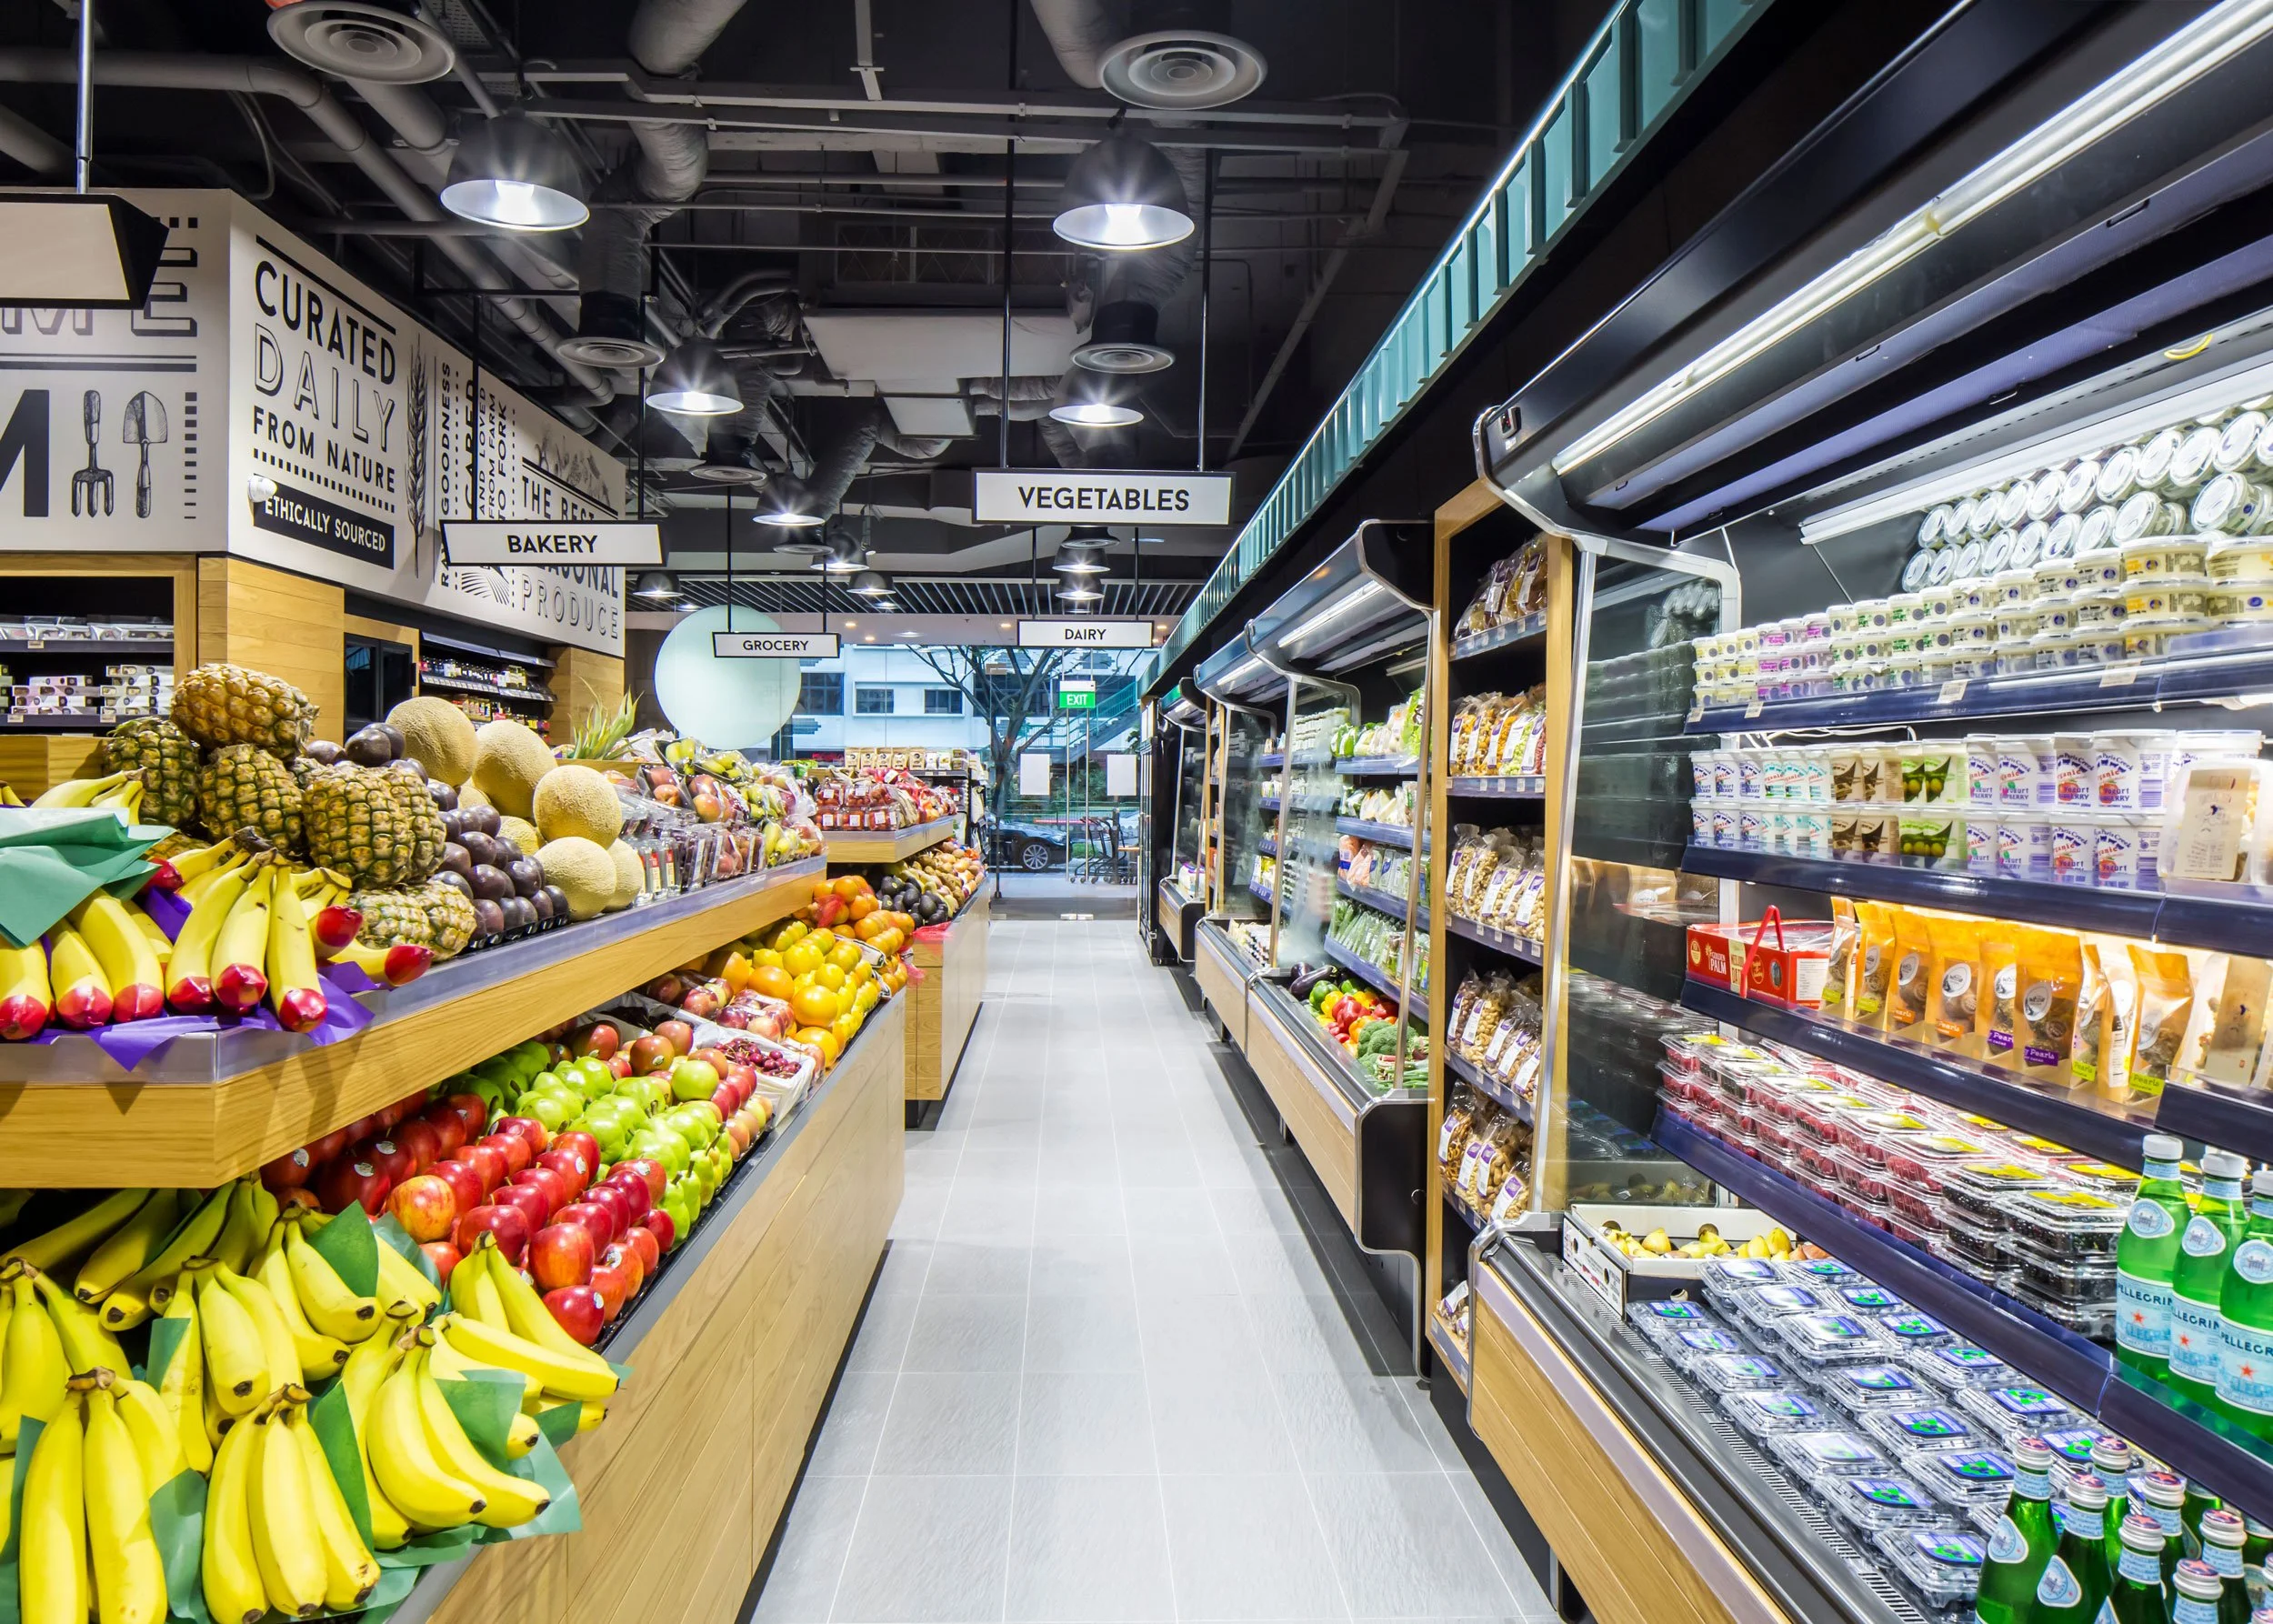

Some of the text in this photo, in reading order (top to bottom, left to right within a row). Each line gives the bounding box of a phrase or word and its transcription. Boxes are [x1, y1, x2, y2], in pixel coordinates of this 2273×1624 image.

[255, 260, 396, 386] CURATED
[255, 323, 396, 453] DAILY
[254, 405, 396, 494] FROM NATURE
[441, 362, 451, 516] GOODNESS
[497, 401, 506, 477] FORK
[522, 475, 595, 520] THE BE
[1017, 486, 1190, 512] VEGETABLES
[265, 496, 386, 553] ETHICALLY SOURCED
[506, 535, 598, 553] BAKERY
[522, 574, 618, 639] PRODUCE
[743, 640, 809, 651] GROCERY
[1064, 628, 1106, 640] DAIRY
[1066, 694, 1087, 706] EXIT
[1710, 958, 1727, 976] PALM
[2030, 1048, 2055, 1059] Pearls
[2133, 1074, 2160, 1087] Pearls
